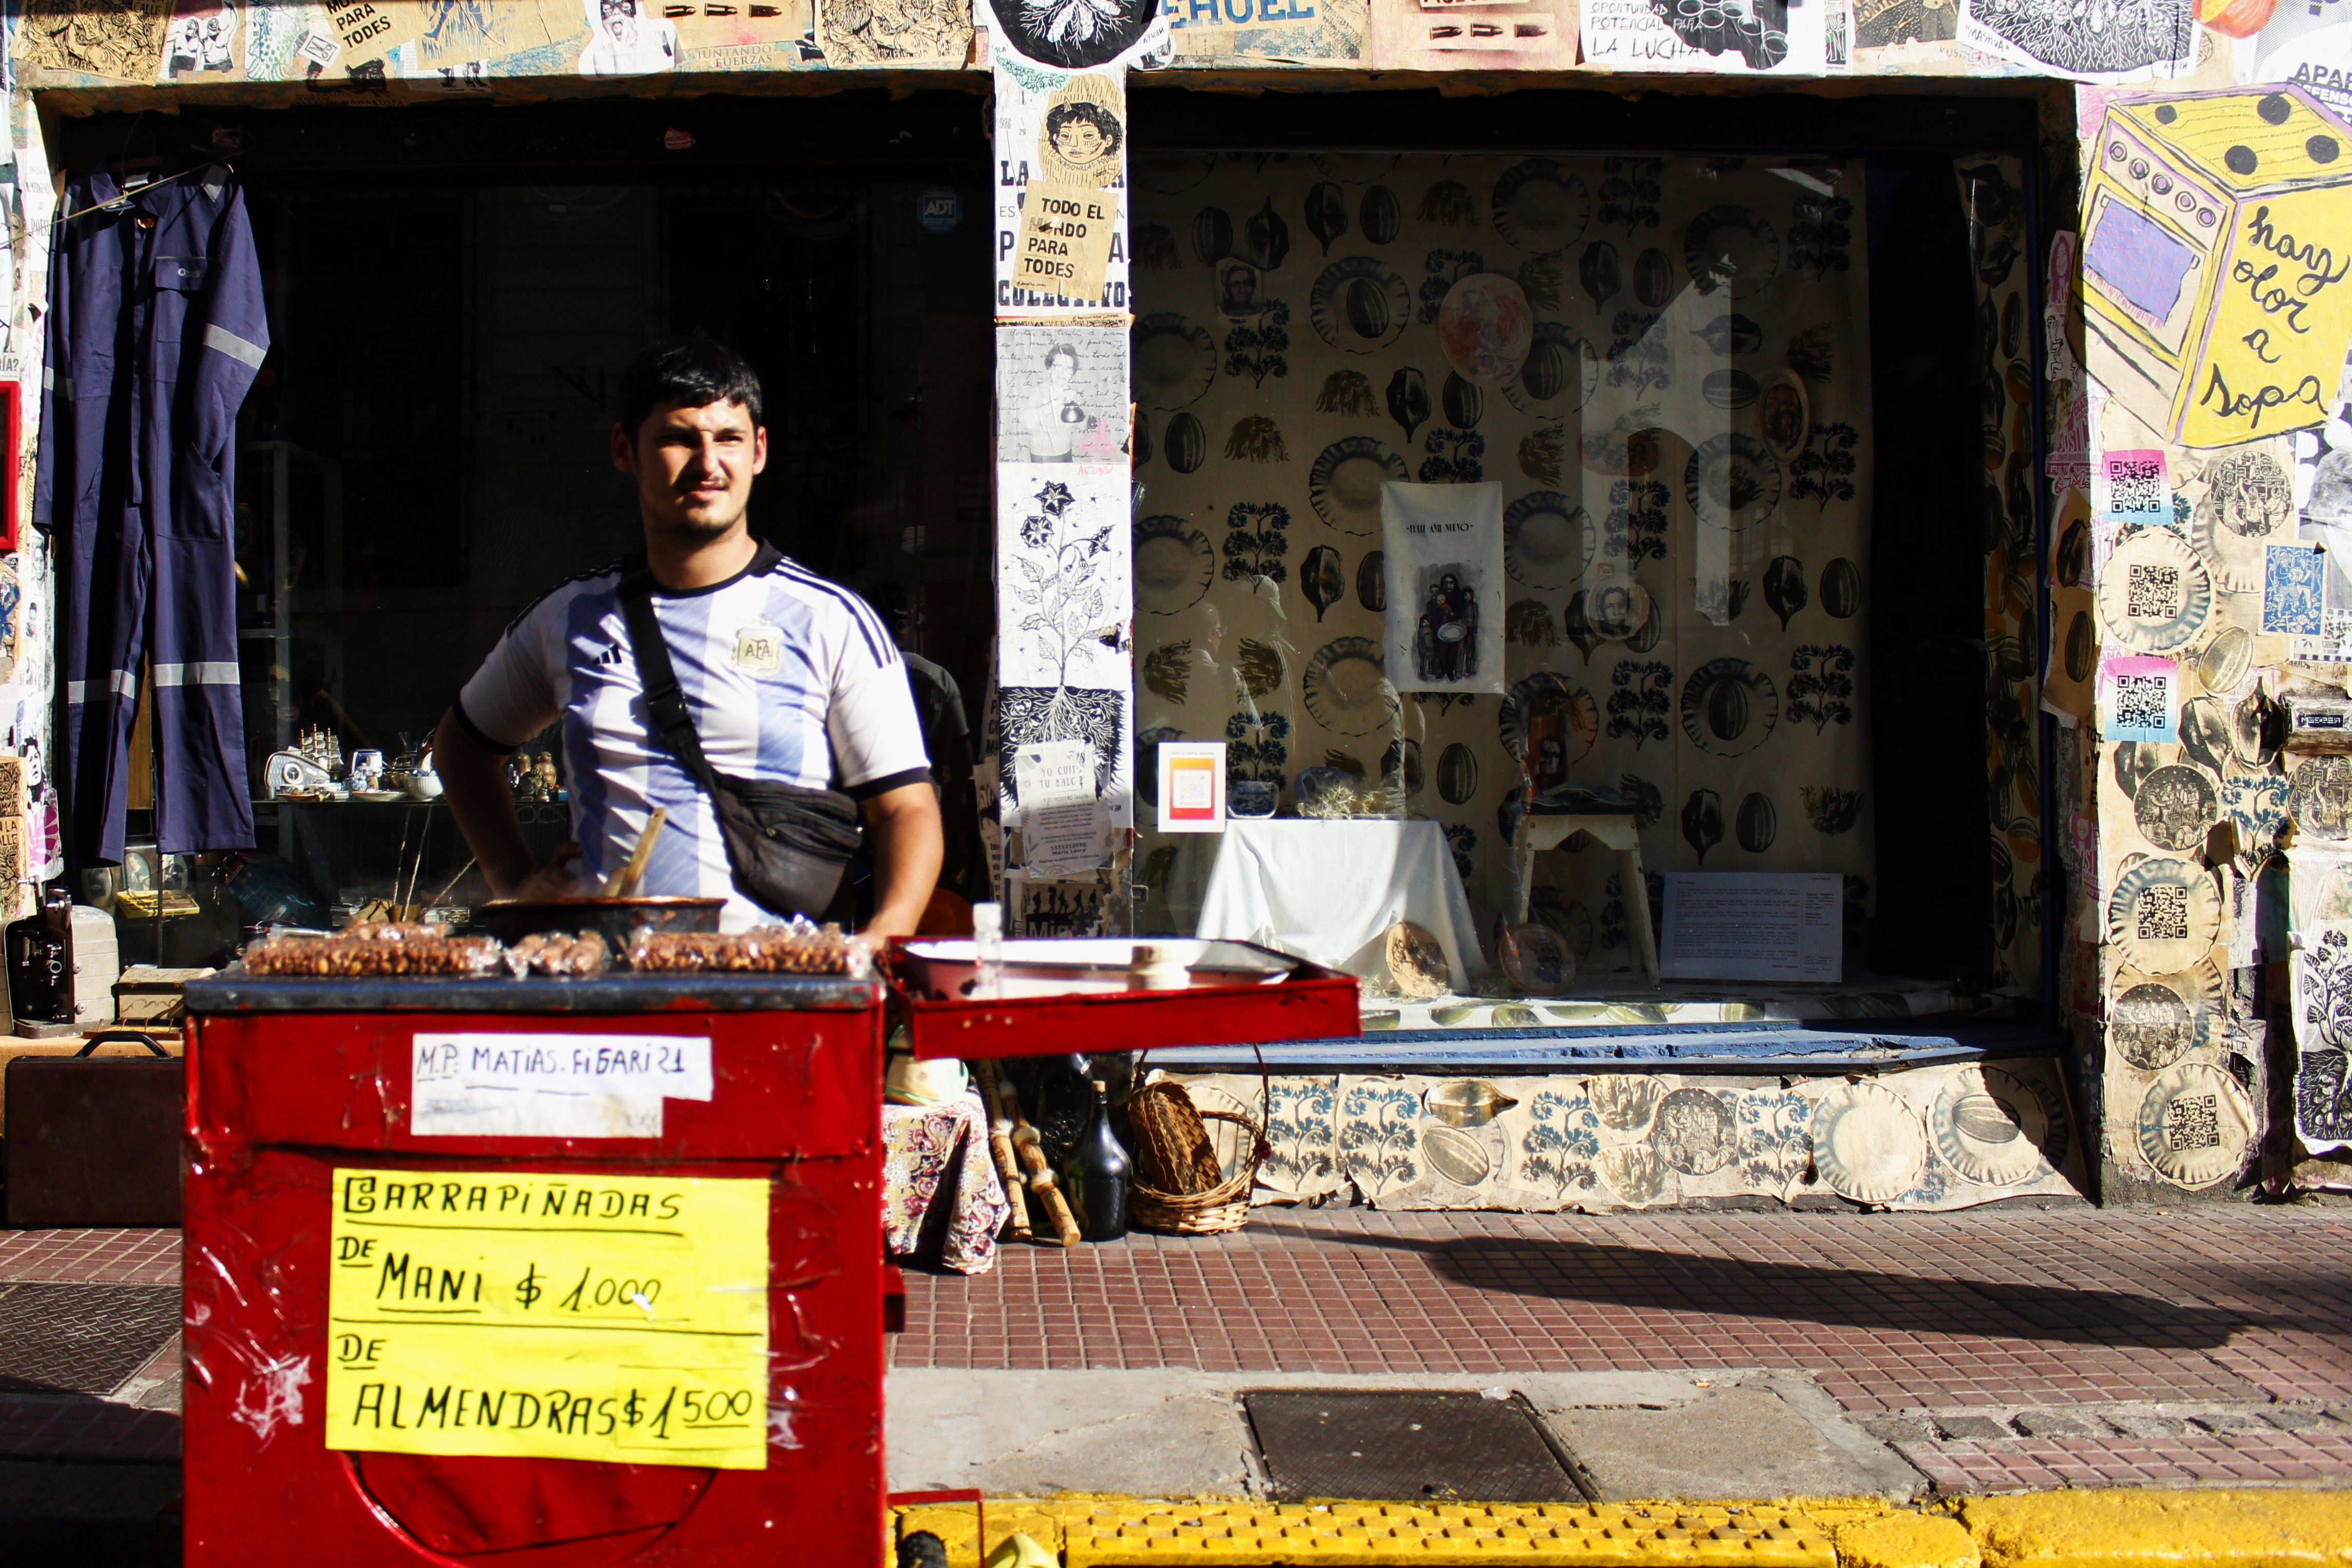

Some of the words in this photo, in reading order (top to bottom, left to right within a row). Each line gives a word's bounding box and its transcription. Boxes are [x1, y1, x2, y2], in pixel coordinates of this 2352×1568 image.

[336, 3, 375, 31] PARA
[343, 16, 391, 49] TODES
[697, 44, 772, 61] JUNTANDO
[1591, 36, 1618, 58] LA
[1631, 37, 1701, 59] LUCHA
[716, 54, 773, 68] FUERZAS
[1000, 160, 1029, 186] LA
[924, 200, 955, 215] ADT
[1000, 206, 1015, 218] ES
[1041, 198, 1081, 216] TODO
[1087, 204, 1105, 220] EL
[1028, 237, 1068, 256] PARA
[2247, 205, 2350, 297] hay
[1024, 258, 1075, 278] TODES
[2233, 259, 2311, 335] olor
[2242, 327, 2284, 364] a
[744, 639, 772, 660] AFA
[1041, 767, 1053, 778] YO
[1039, 779, 1050, 789] TU
[6, 820, 17, 832] LA
[337, 1235, 378, 1261] DE
[337, 1333, 387, 1363] DE
[352, 1383, 617, 1436] ALMENDRAS
